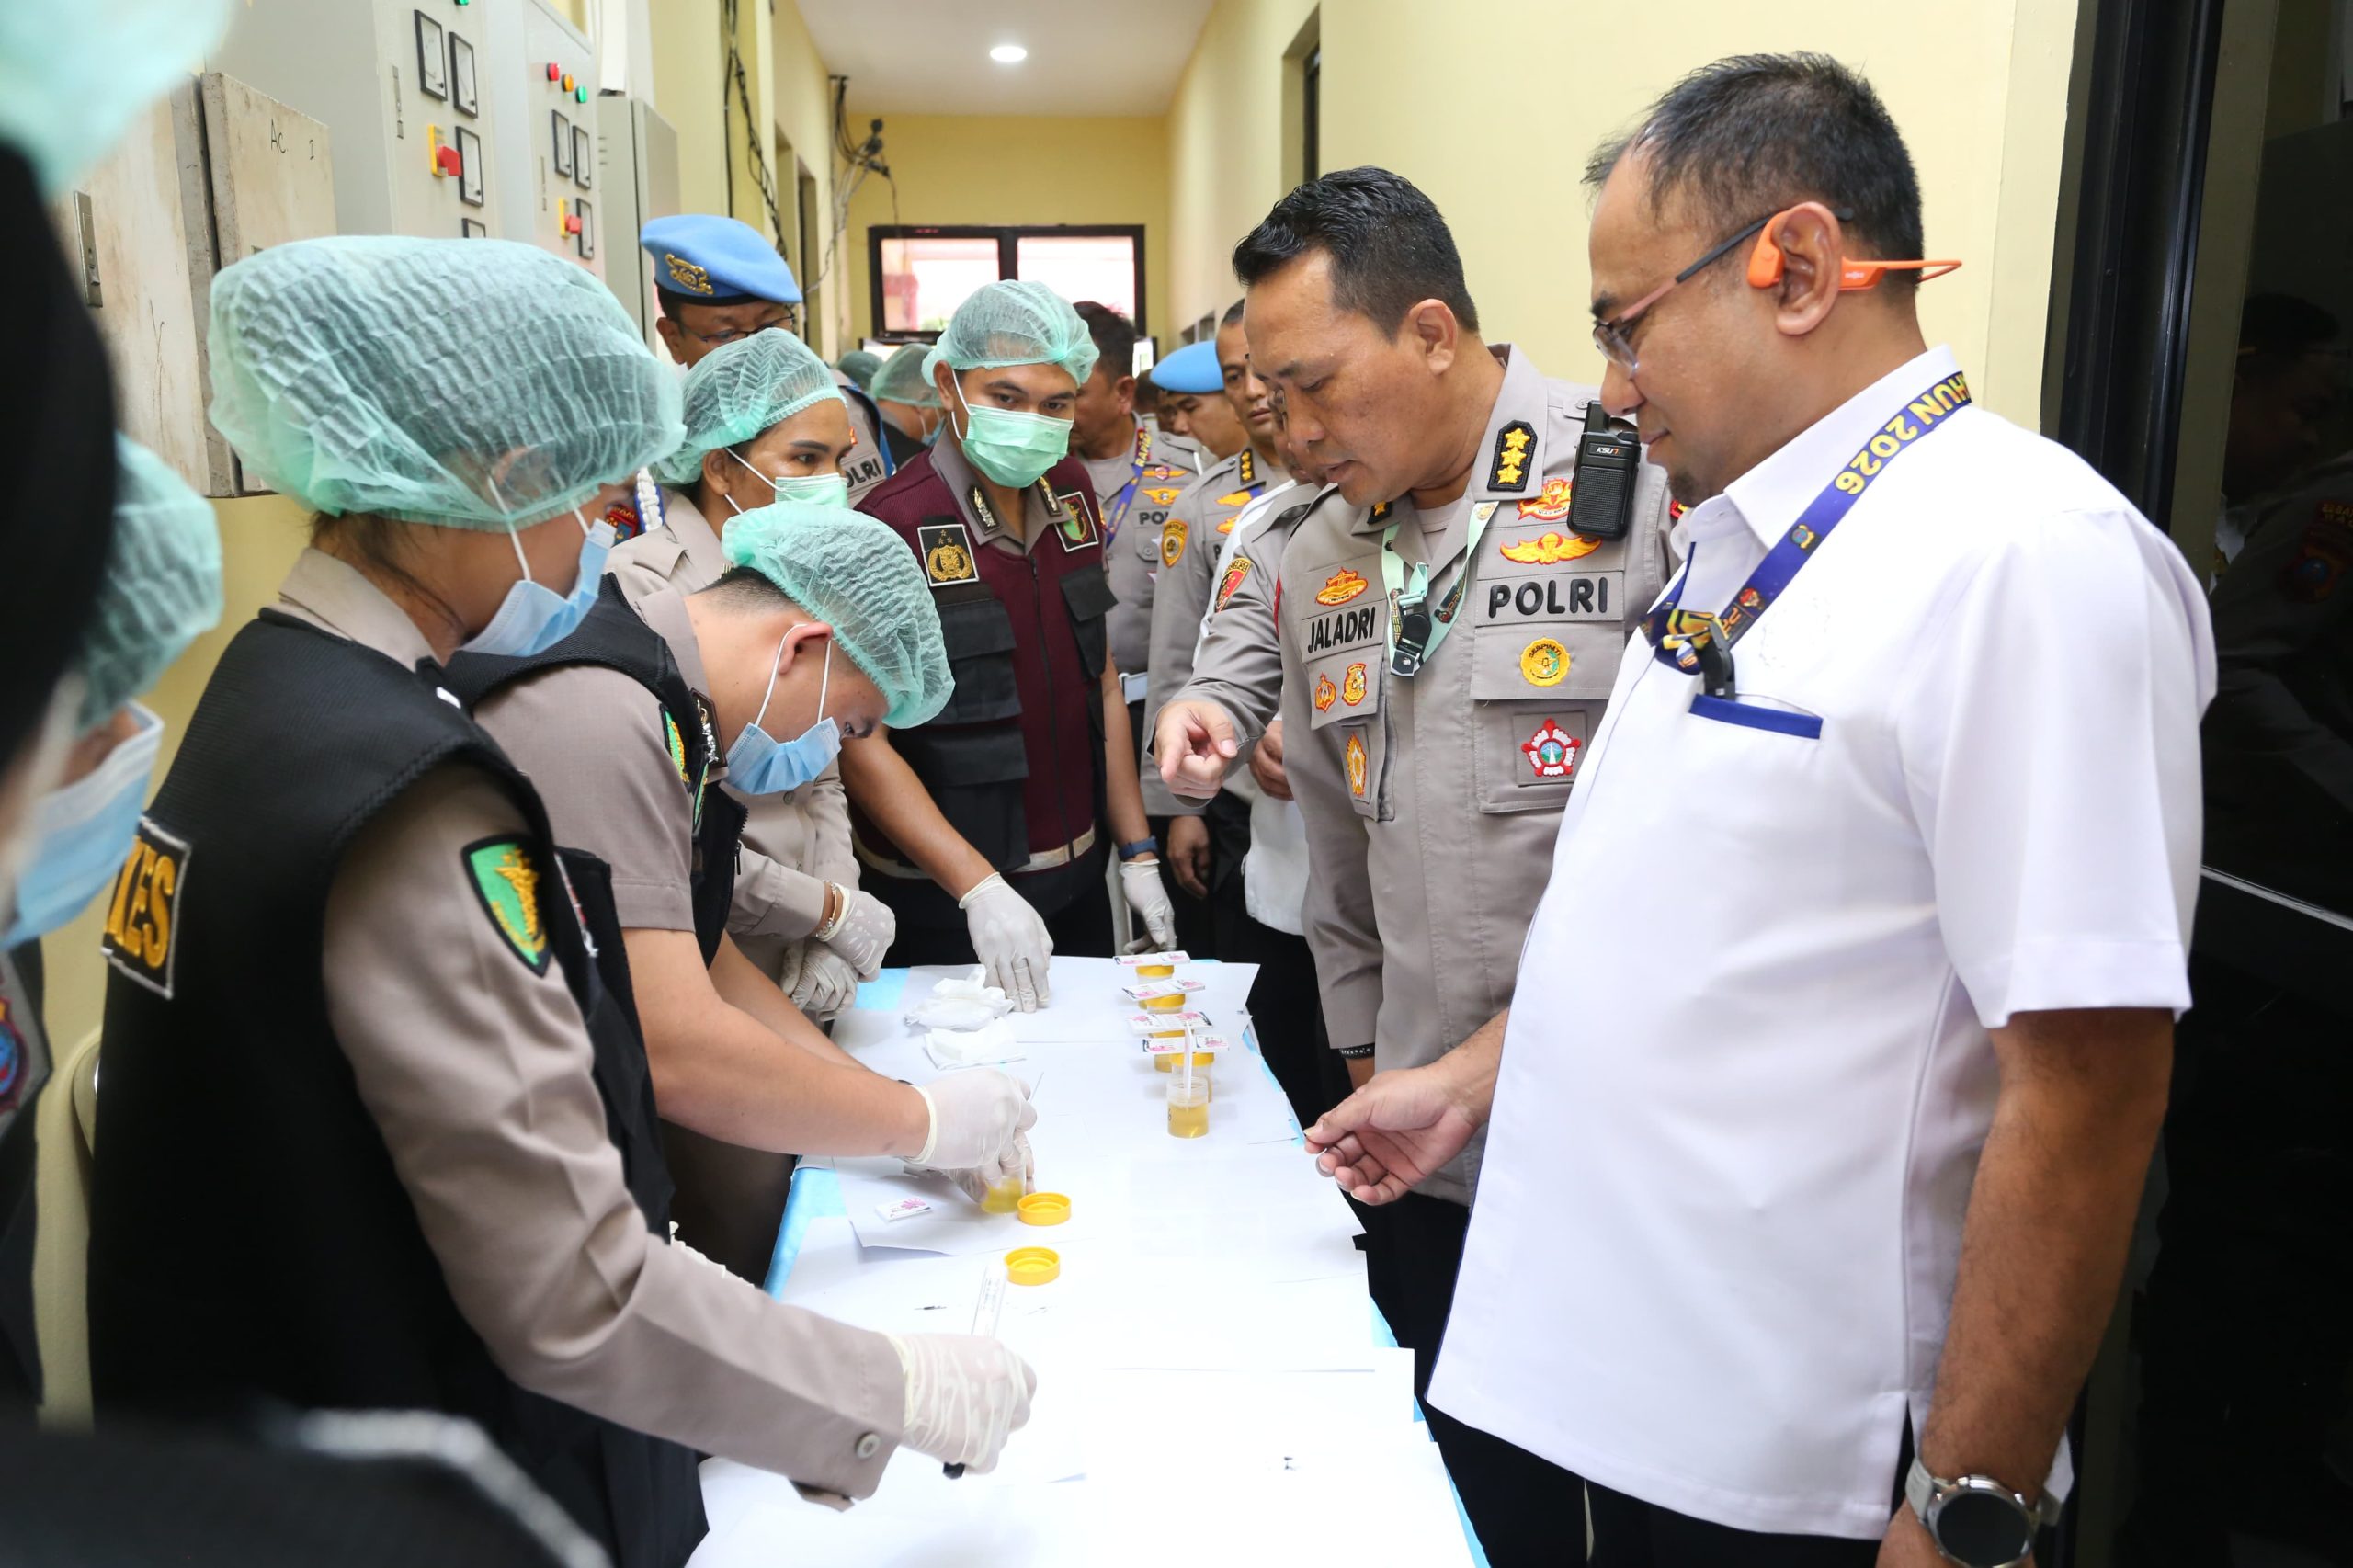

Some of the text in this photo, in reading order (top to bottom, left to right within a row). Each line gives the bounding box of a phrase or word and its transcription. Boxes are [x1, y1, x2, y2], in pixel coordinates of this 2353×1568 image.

[270, 118, 287, 154] AC
[1834, 373, 1971, 495] HUN 2026
[845, 458, 882, 488] OLRI
[1138, 510, 1169, 526] PO
[1488, 576, 1608, 619] POLRI
[1307, 606, 1376, 654] JALADRI
